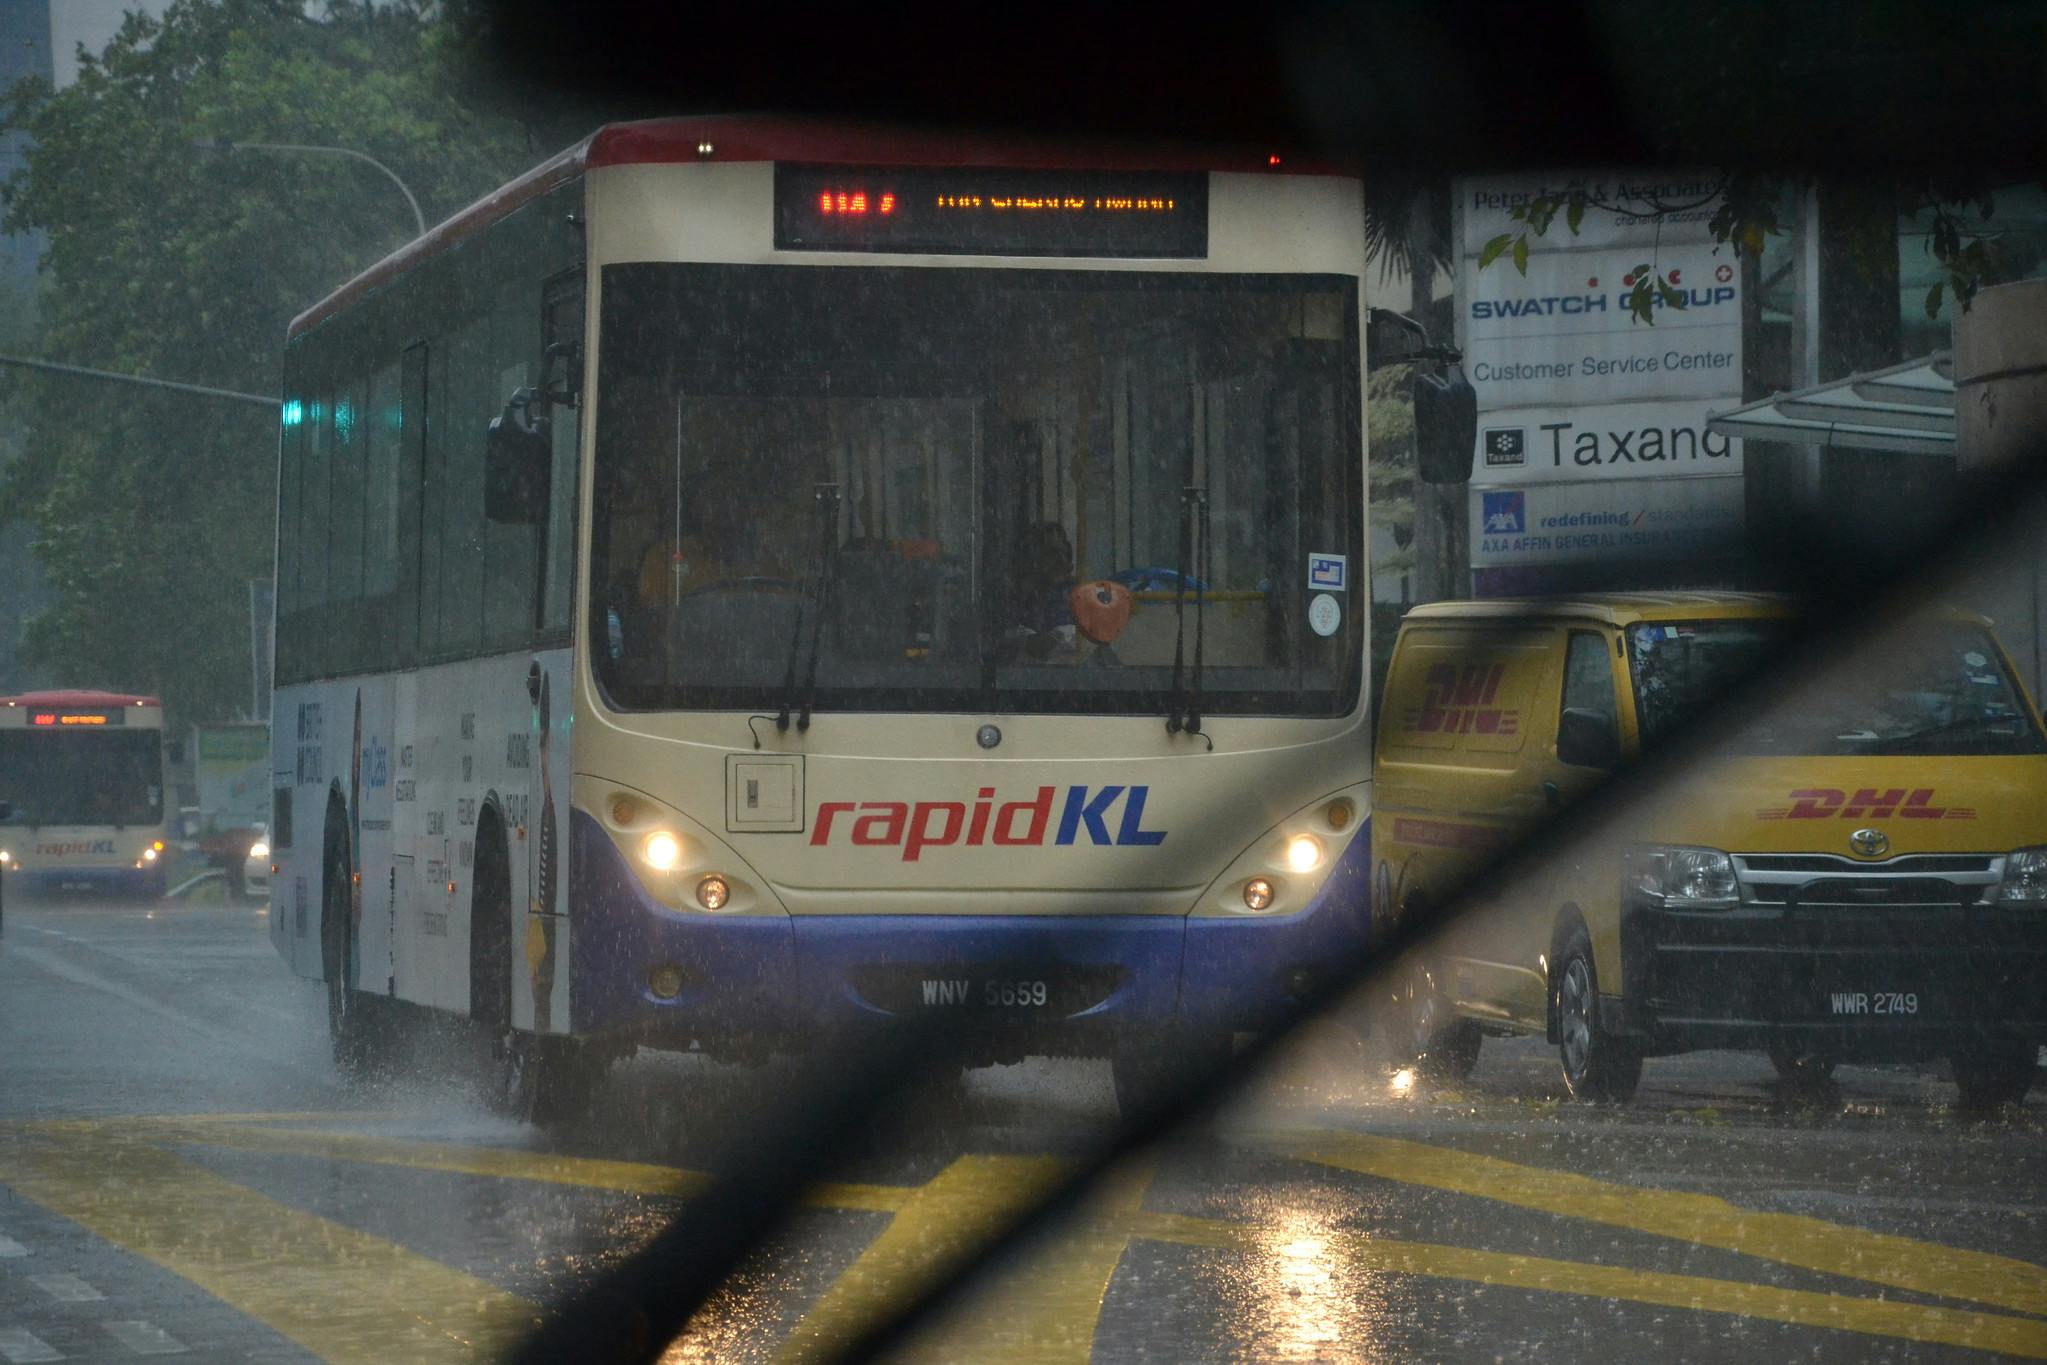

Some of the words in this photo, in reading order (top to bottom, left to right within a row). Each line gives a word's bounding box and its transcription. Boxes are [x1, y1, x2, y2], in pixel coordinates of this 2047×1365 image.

[1616, 180, 1722, 201] Associate
[1472, 294, 1607, 320] SWATCH
[1474, 361, 1574, 382] Customer
[1582, 355, 1659, 376] Service
[1663, 350, 1734, 371] Center
[1487, 452, 1524, 464] Taxand
[1540, 511, 1630, 528] redefining
[1482, 539, 1509, 552] AXA
[1512, 536, 1551, 551] AFFIN
[1554, 533, 1617, 550] GENERAL
[1785, 789, 1948, 819] DHL
[809, 785, 1168, 861] rapidKL
[922, 980, 969, 1006] WNV
[1831, 993, 1869, 1014] WWR
[1873, 993, 1918, 1014] 2749
